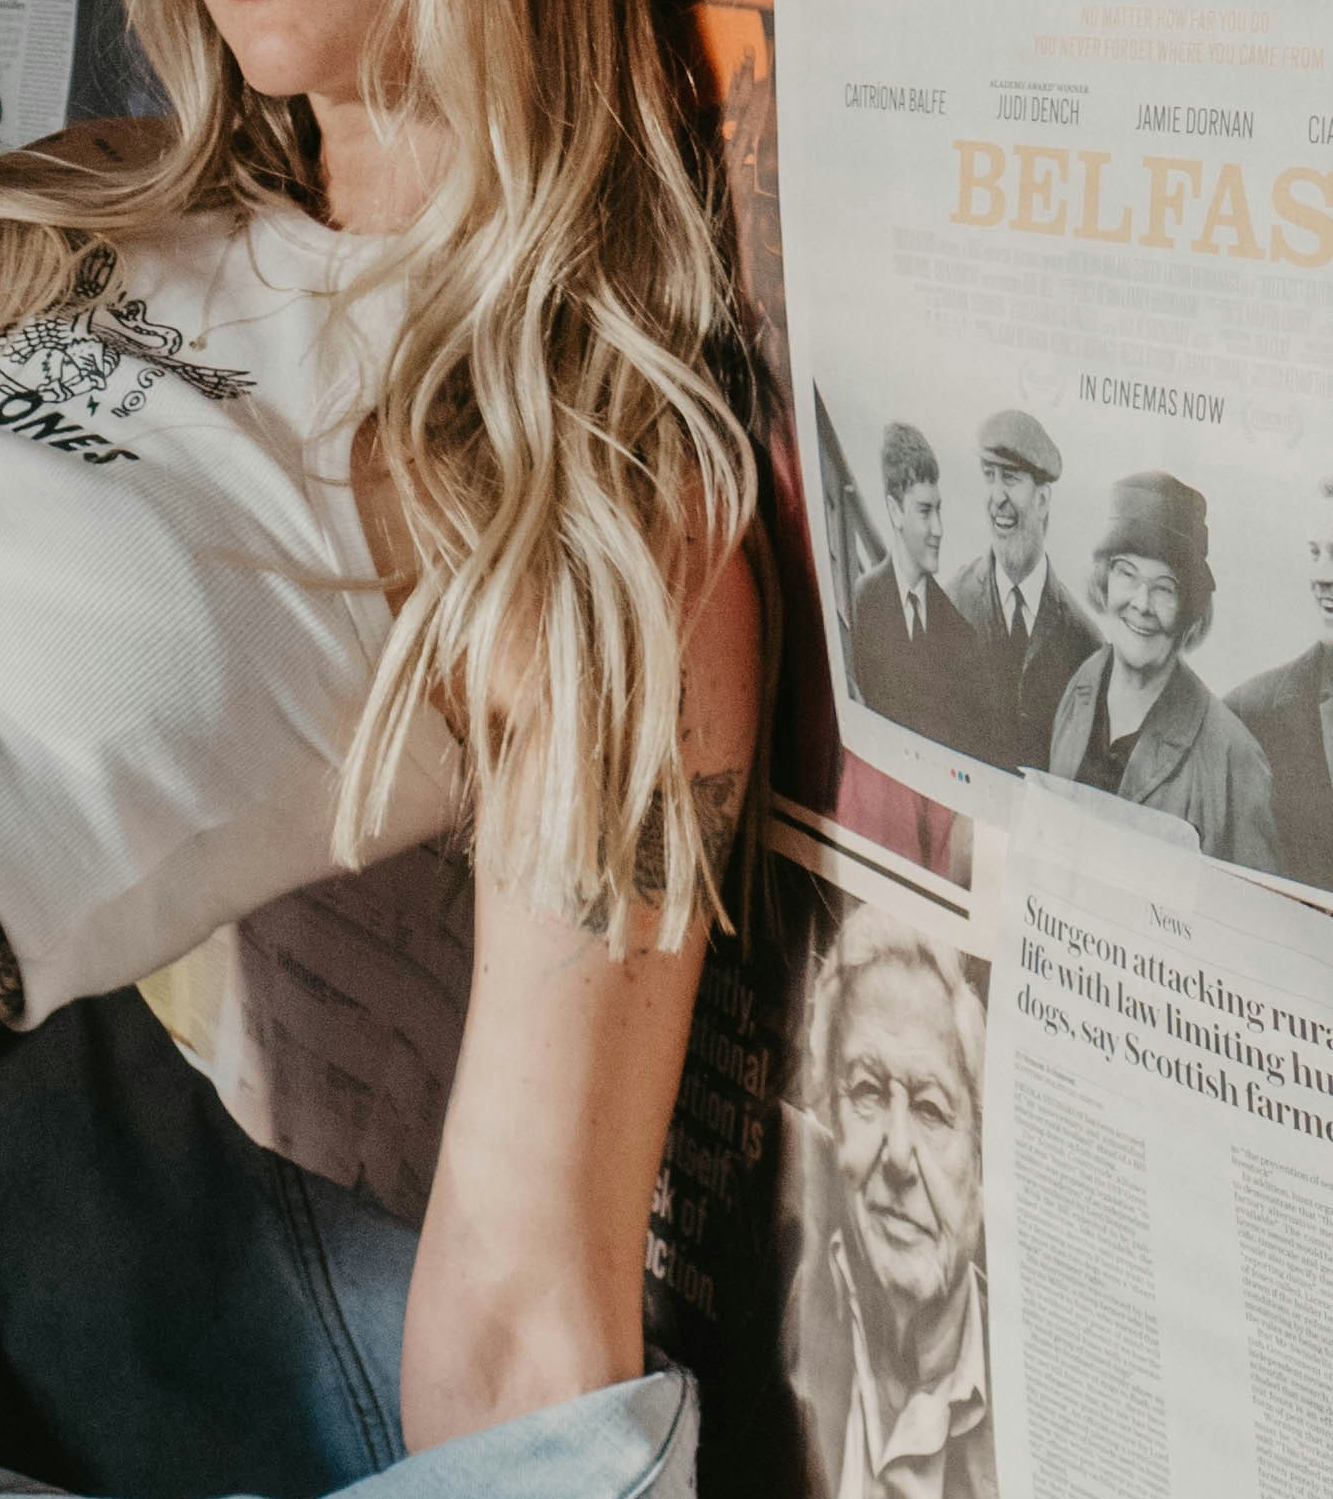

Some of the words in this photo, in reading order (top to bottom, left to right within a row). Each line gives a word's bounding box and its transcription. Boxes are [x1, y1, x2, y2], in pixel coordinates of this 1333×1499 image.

[907, 87, 948, 116] BALFE
[996, 93, 1028, 123] JUDI
[1030, 96, 1081, 127] DENCH
[1135, 104, 1183, 135] JAMIE
[1185, 107, 1255, 140] DORNAN
[1078, 372, 1098, 403] IN
[1101, 377, 1181, 418] CINEMAS
[1182, 393, 1226, 426] NOW
[1150, 902, 1193, 941] News
[1023, 894, 1128, 970] Sturgeon
[1132, 951, 1265, 1034] attacking
[1020, 935, 1053, 981] life
[1057, 963, 1111, 1009] with
[1117, 980, 1162, 1030] law
[1165, 1002, 1287, 1087] limiting
[1016, 982, 1077, 1040] dogs,
[1081, 1019, 1120, 1063] say
[1123, 1031, 1239, 1108] Scottish
